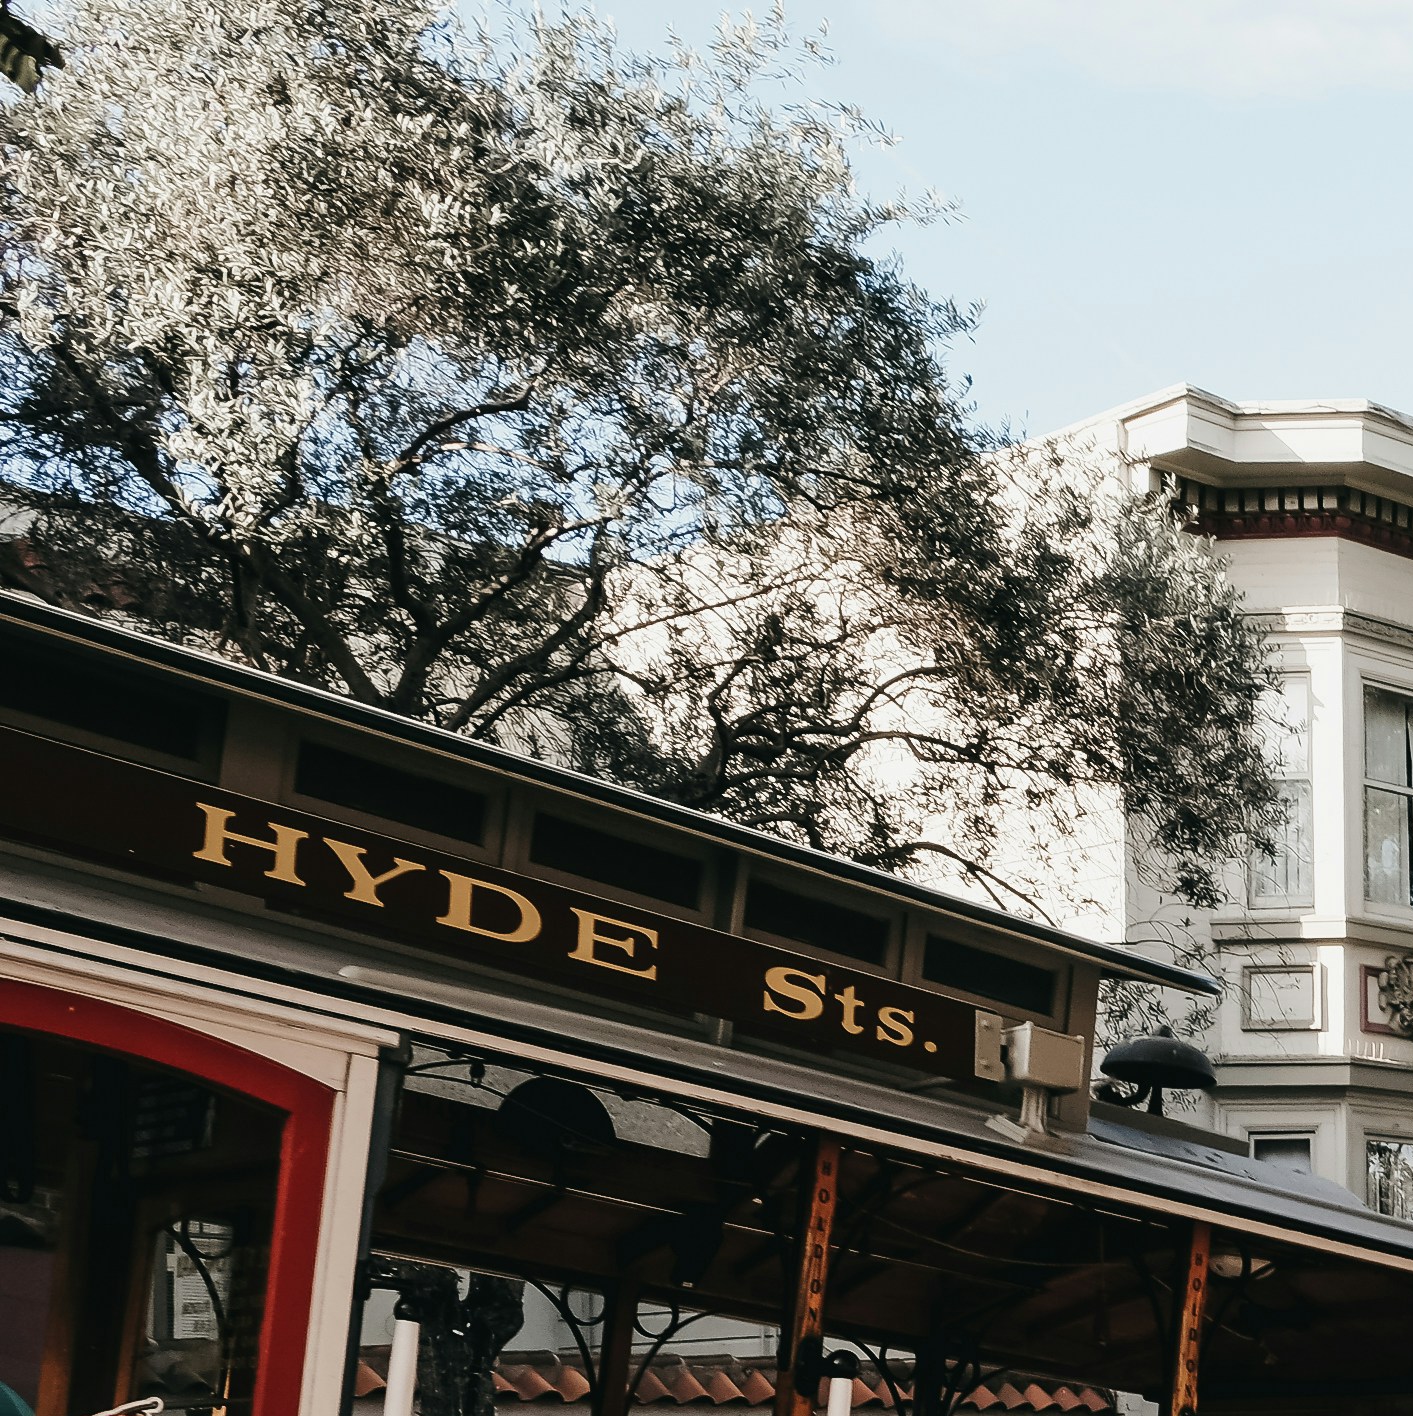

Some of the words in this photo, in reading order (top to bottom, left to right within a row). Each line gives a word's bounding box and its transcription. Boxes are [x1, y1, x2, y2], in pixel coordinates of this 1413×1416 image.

[193, 802, 661, 982] HYDE
[762, 965, 937, 1053] Sts.
[814, 1160, 832, 1259] HOLD
[808, 1278, 822, 1322] ON
[1188, 1252, 1204, 1342] HOLD
